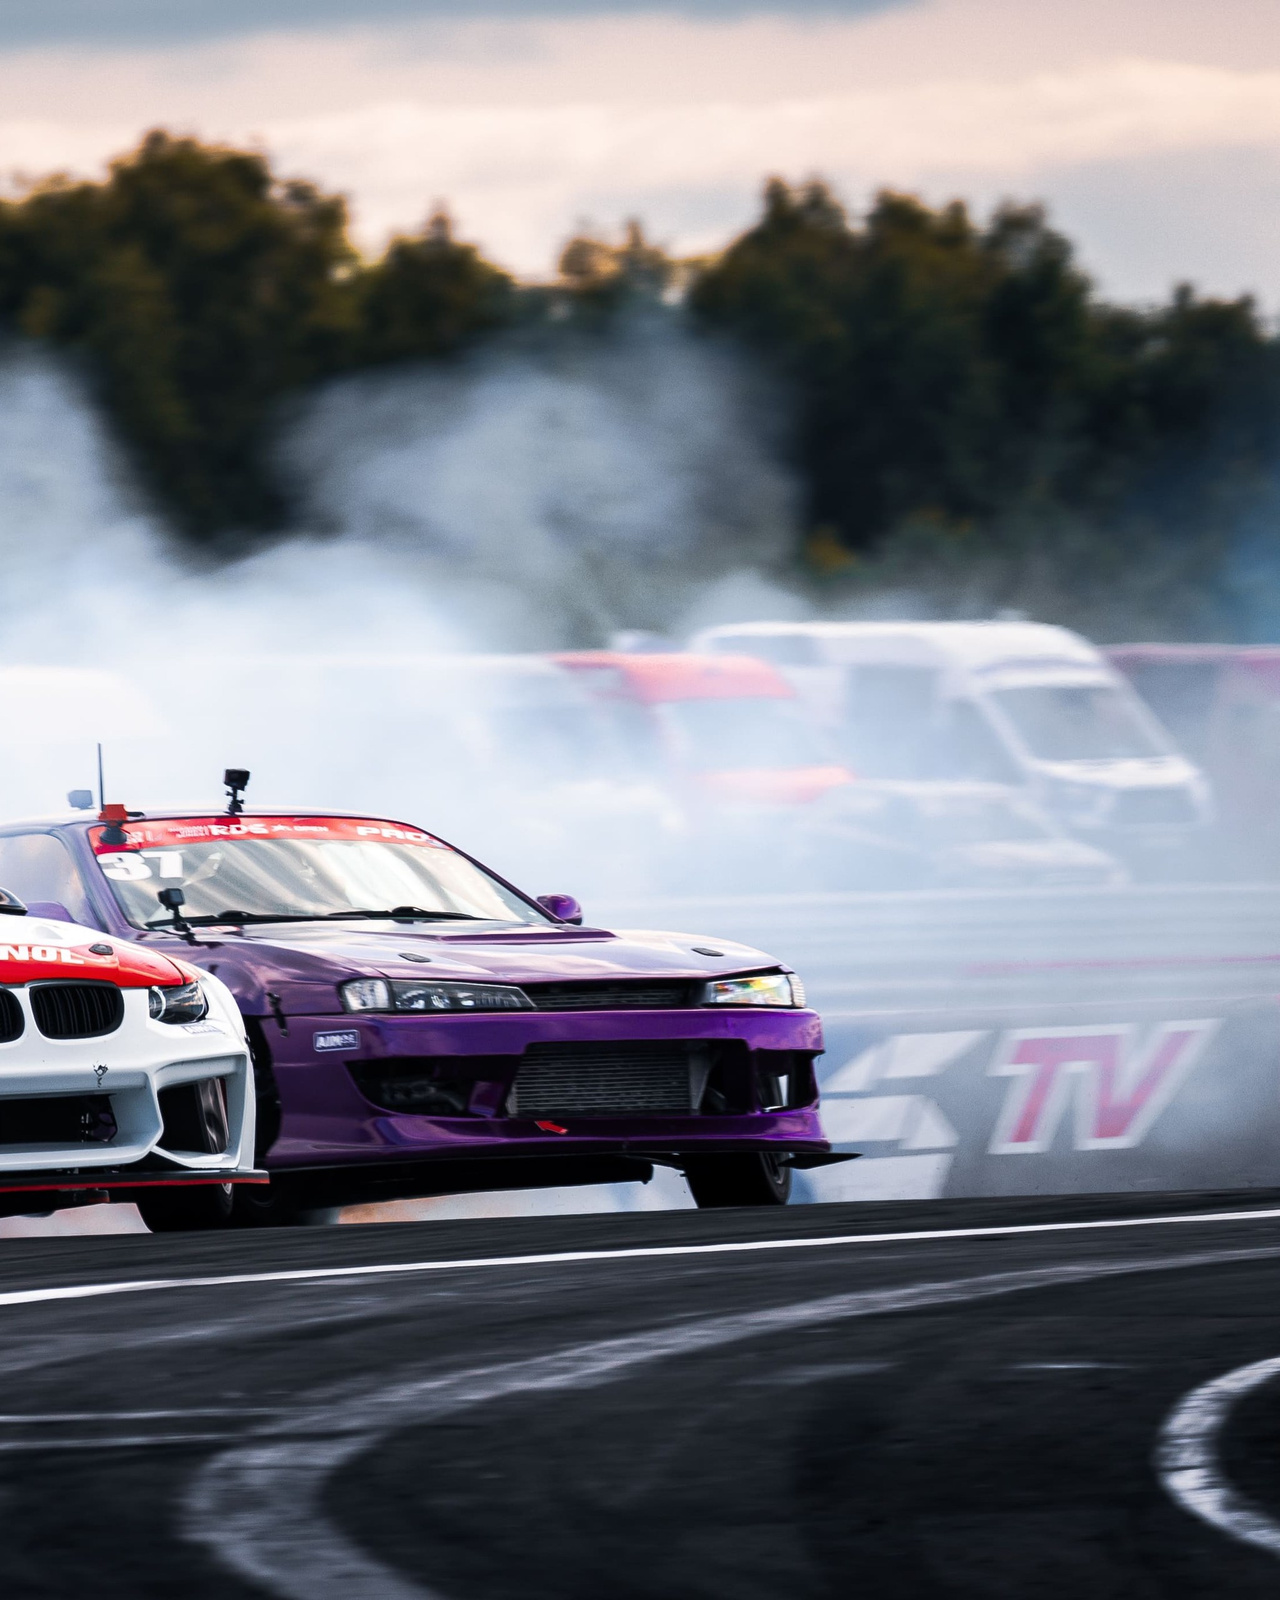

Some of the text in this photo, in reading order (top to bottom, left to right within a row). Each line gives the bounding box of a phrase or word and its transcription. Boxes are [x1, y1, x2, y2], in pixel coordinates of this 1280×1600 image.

[209, 824, 269, 836] RDS
[357, 826, 430, 842] PRO
[985, 1018, 1226, 1155] TV
